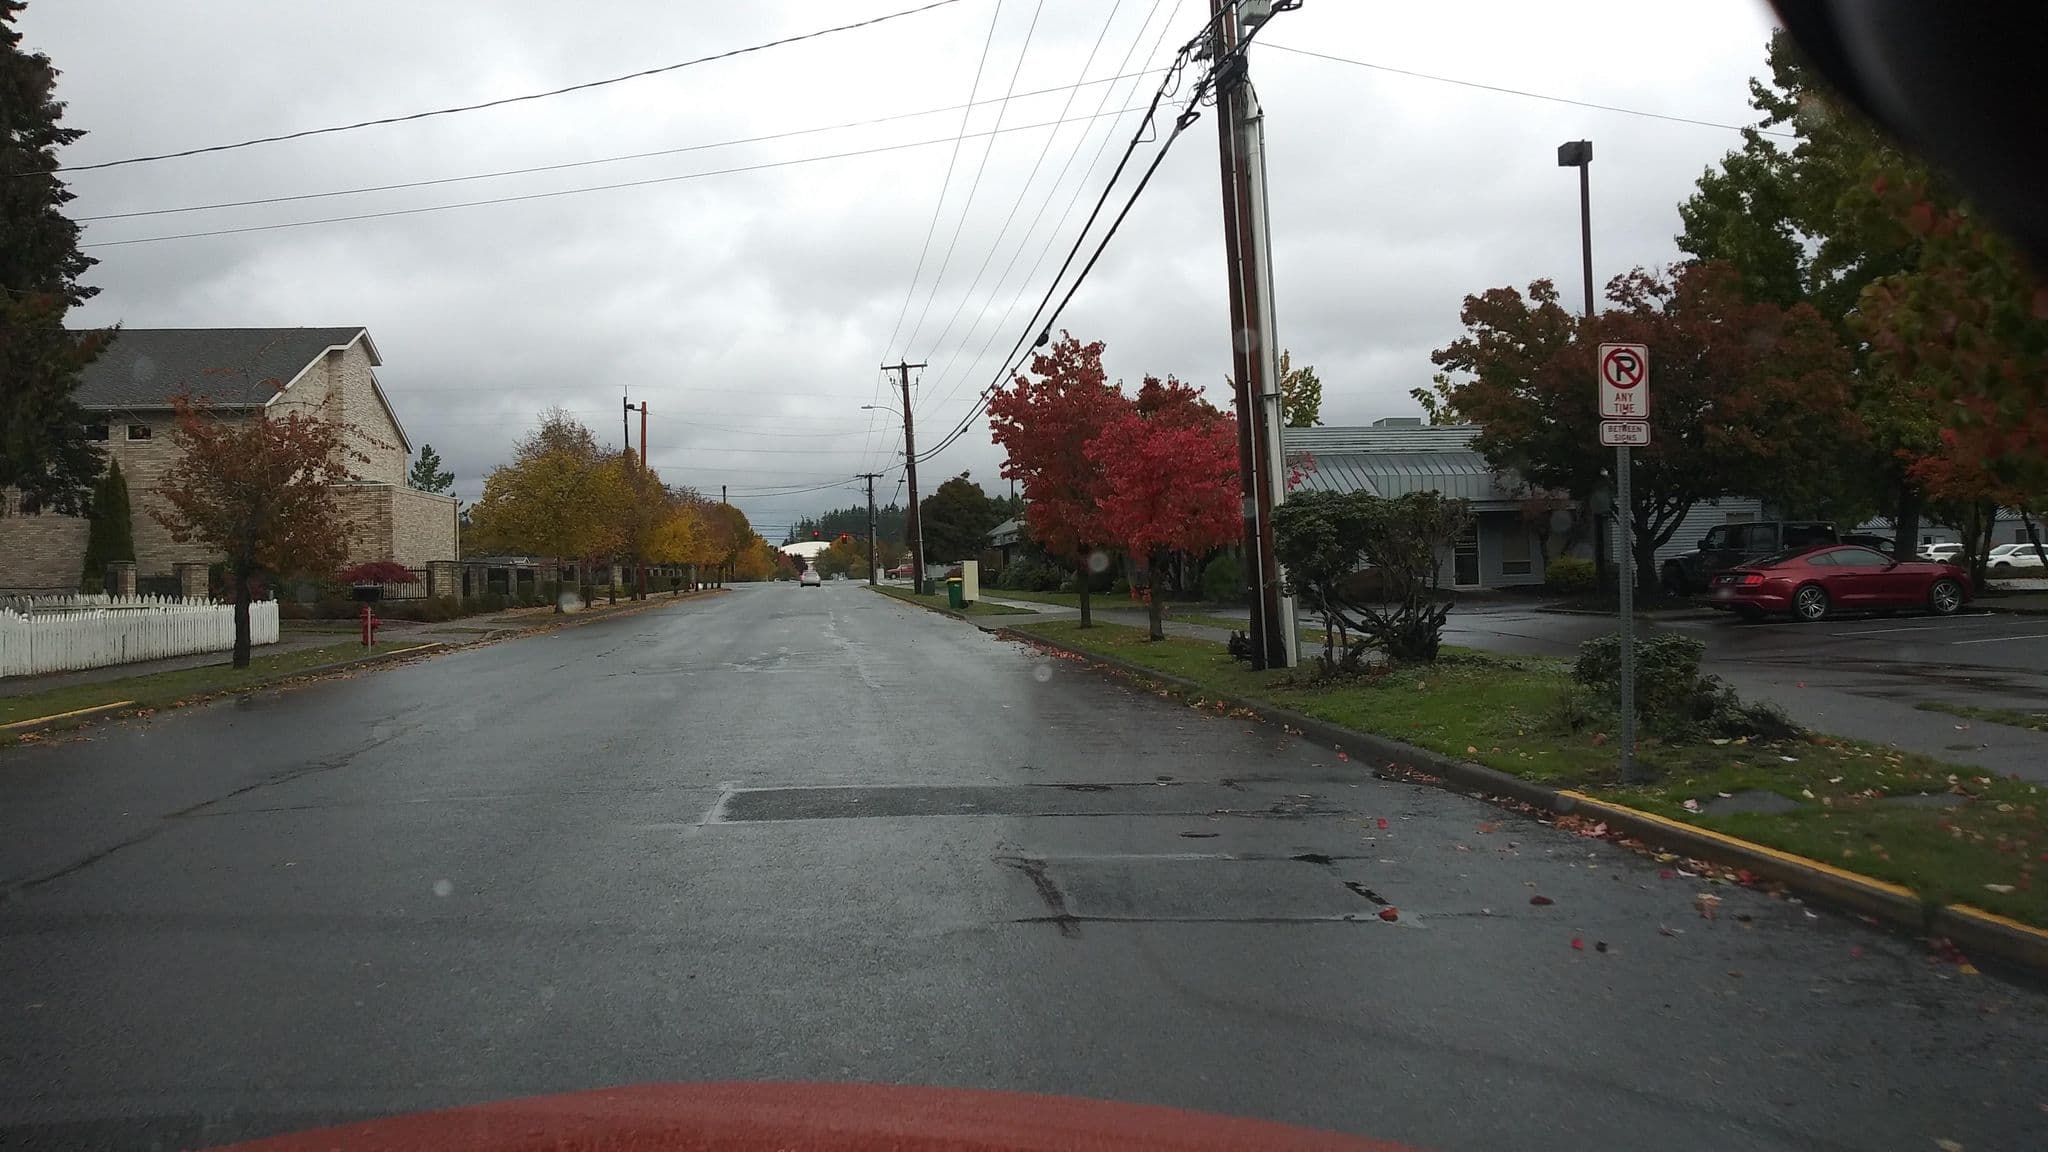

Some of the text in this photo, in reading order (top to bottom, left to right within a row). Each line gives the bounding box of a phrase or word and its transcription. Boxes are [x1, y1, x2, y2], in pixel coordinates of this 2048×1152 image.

[1615, 356, 1637, 381] P
[1615, 392, 1633, 402] ANY
[1614, 403, 1635, 413] TIME
